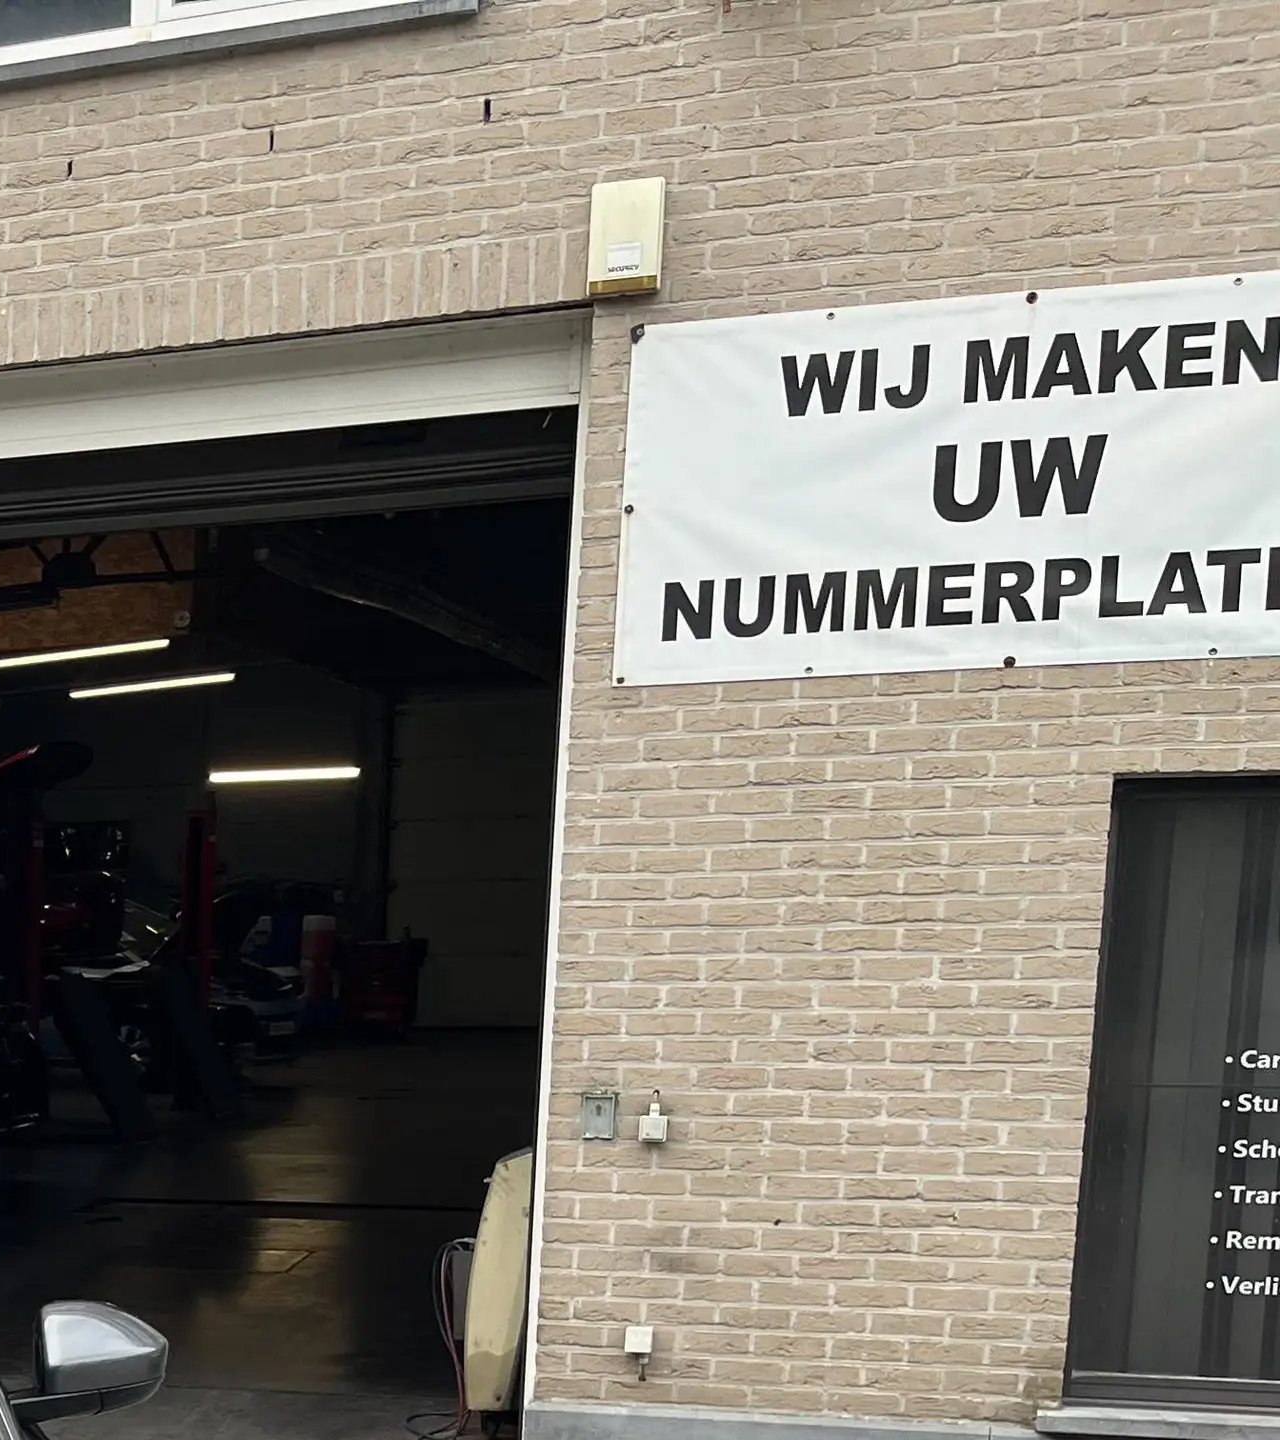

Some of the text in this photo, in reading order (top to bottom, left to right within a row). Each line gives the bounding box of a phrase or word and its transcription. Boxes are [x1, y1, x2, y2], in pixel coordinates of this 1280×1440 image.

[780, 316, 1280, 417] WIJ MAKEN
[932, 434, 1108, 522] UW
[1237, 1093, 1279, 1113] Stu
[1233, 1139, 1280, 1159] Sch
